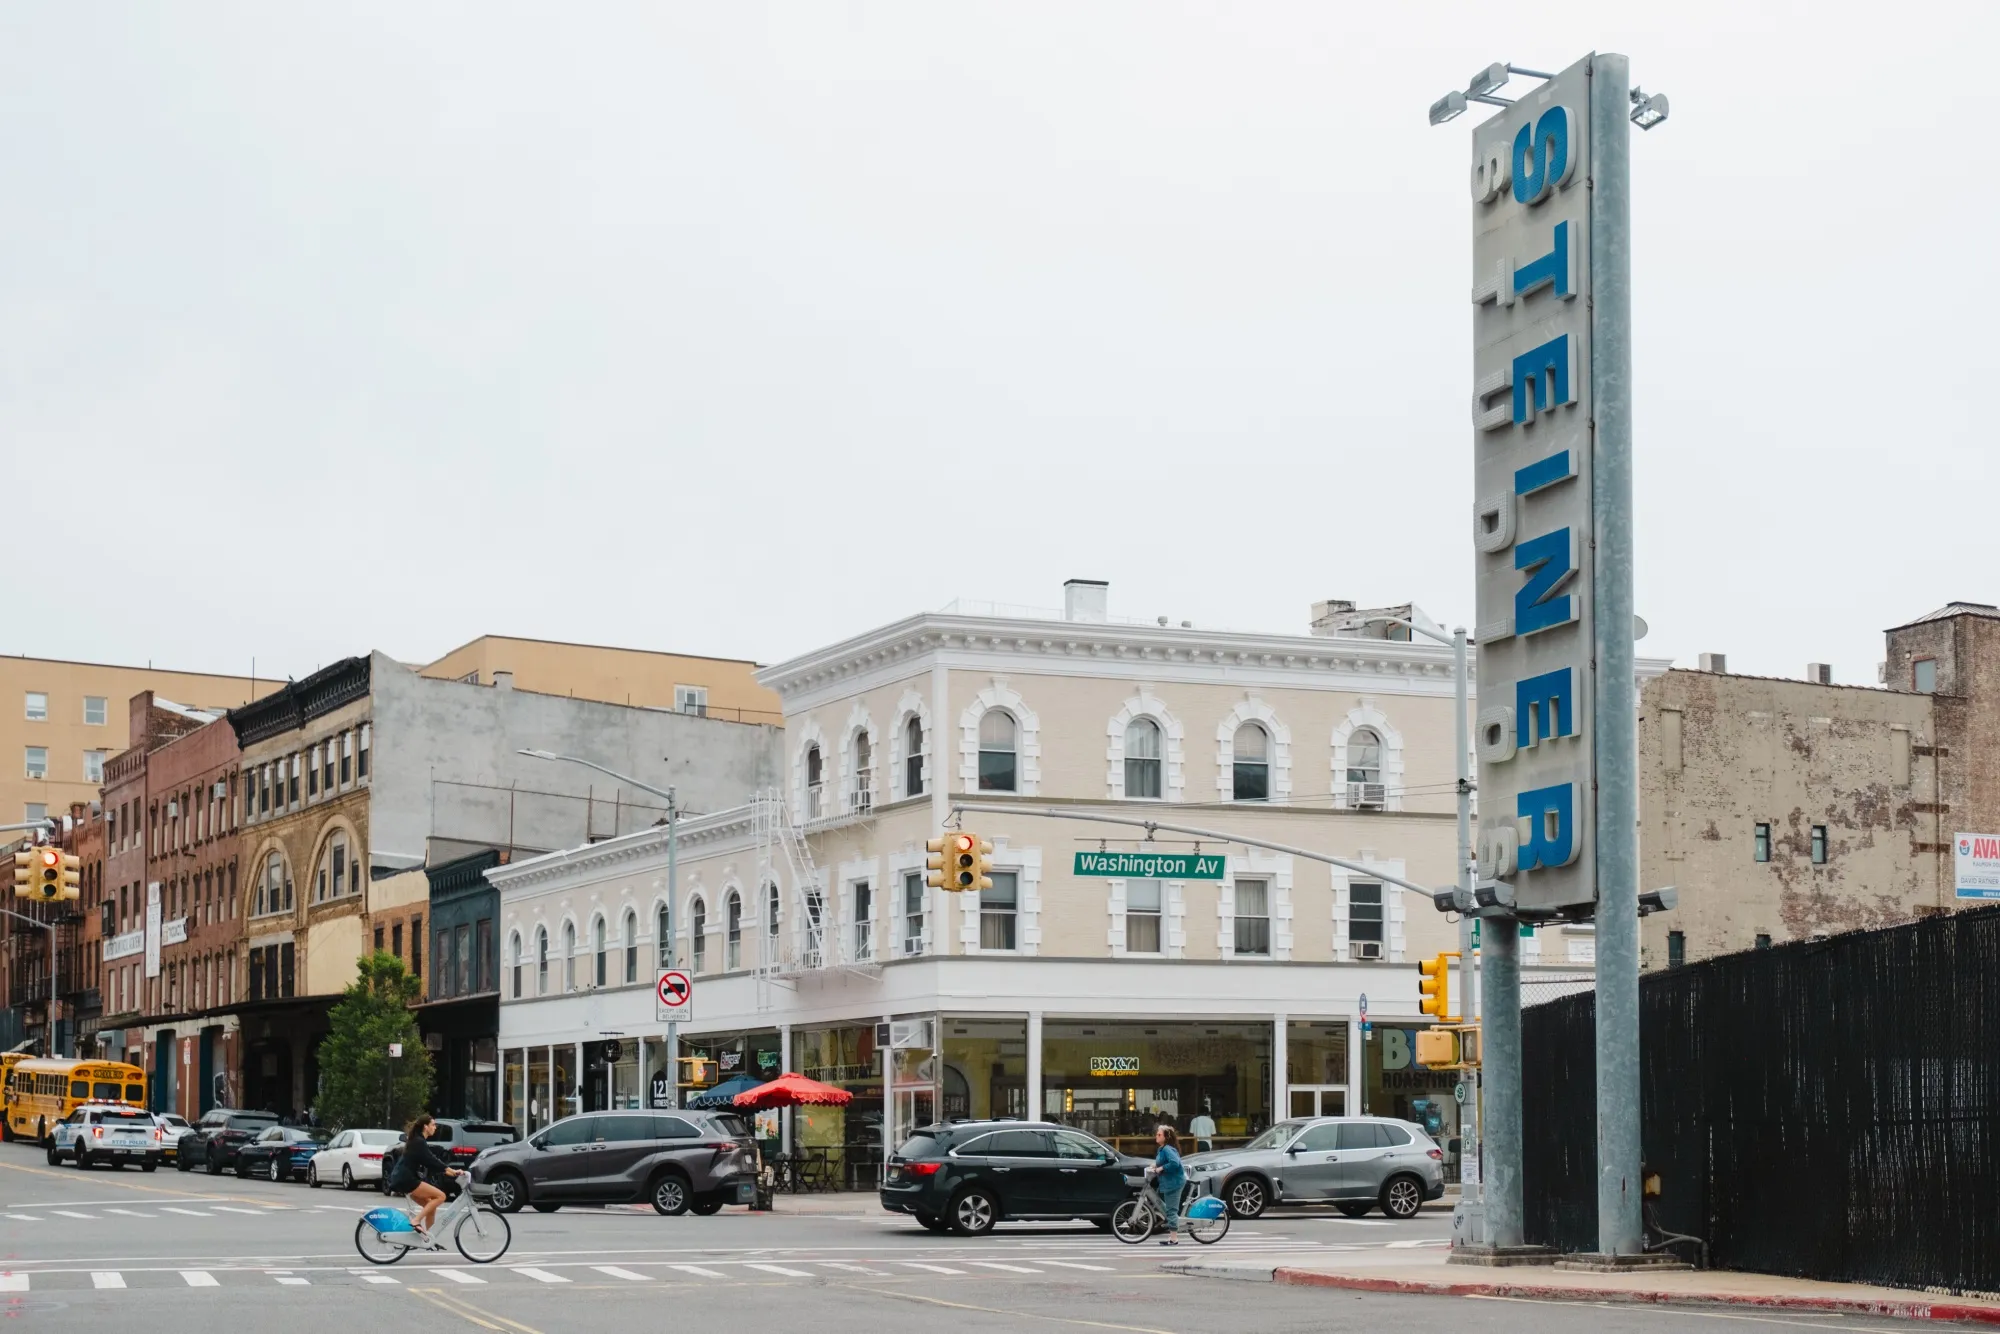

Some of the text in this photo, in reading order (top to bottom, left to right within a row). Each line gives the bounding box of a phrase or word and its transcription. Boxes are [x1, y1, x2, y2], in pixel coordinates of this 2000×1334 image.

[1512, 105, 1578, 872] STEINER
[1471, 140, 1519, 880] STUDIOS
[1973, 838, 2000, 859] AVA
[1080, 854, 1219, 877] Washington Av
[1090, 1057, 1140, 1070] BROOKLYN
[1382, 1072, 1458, 1089] ROASTING
